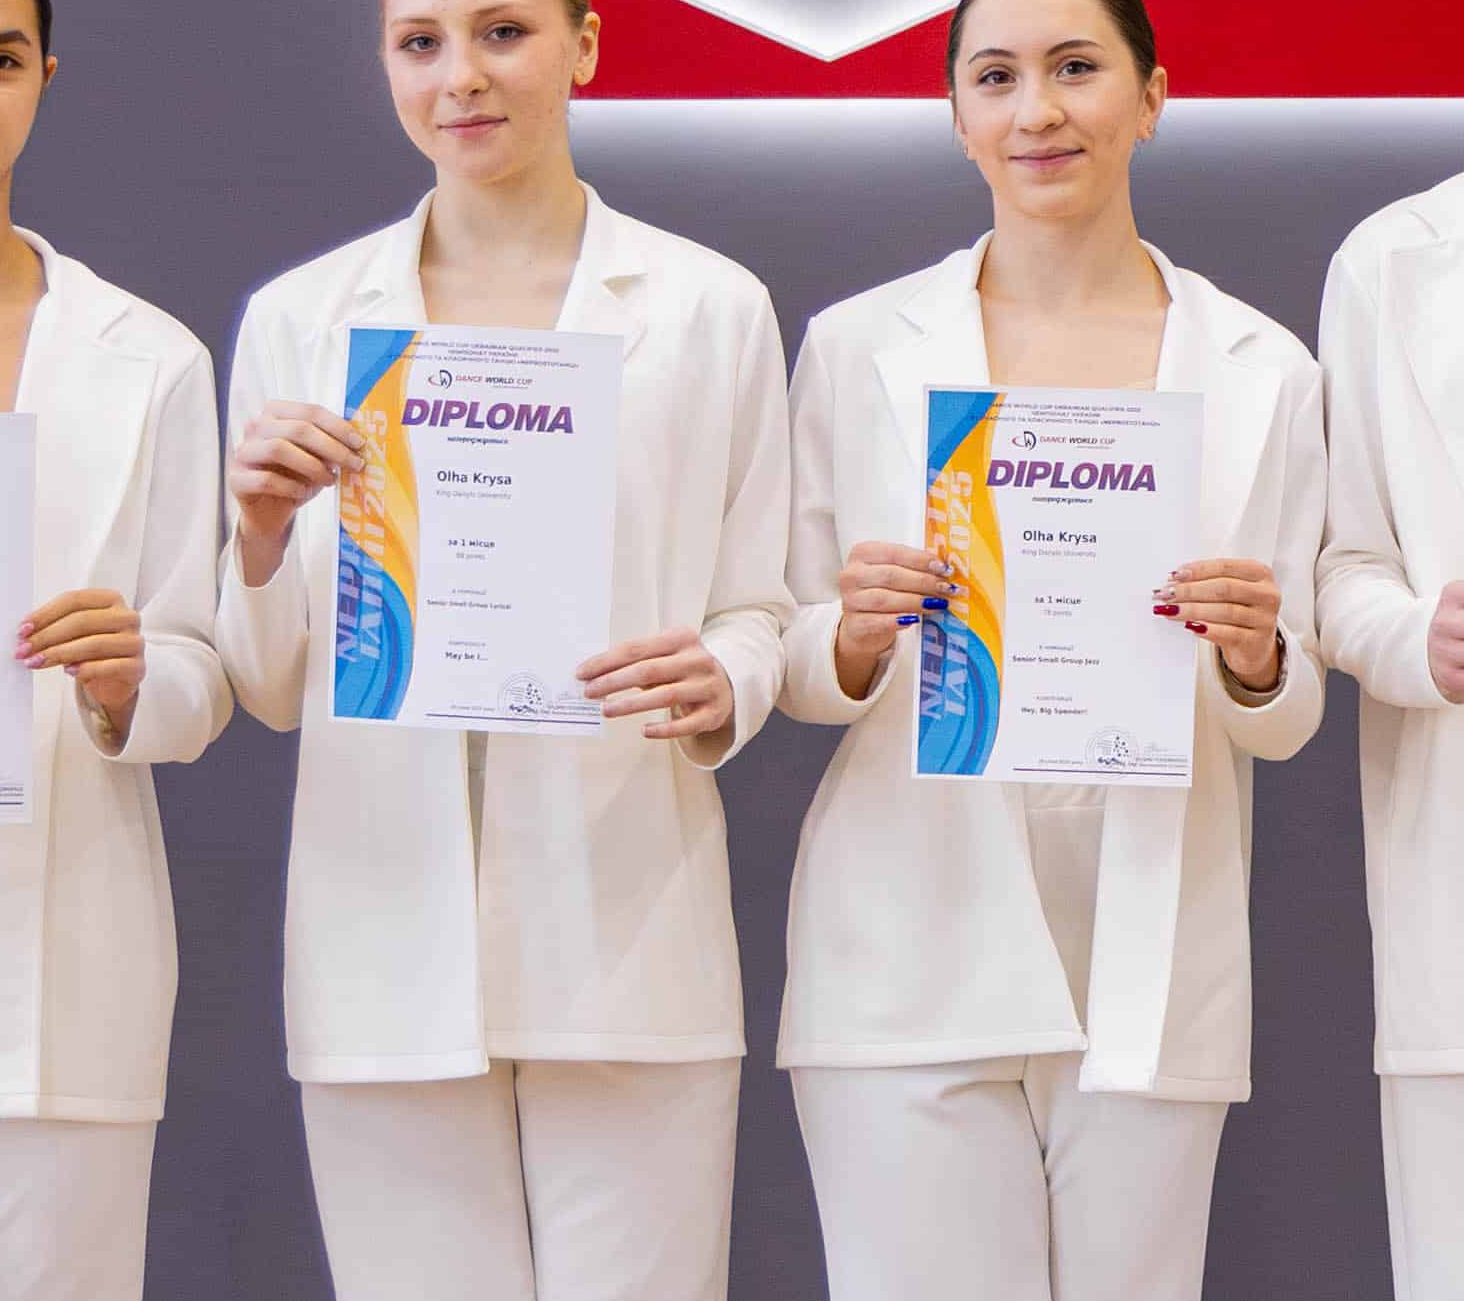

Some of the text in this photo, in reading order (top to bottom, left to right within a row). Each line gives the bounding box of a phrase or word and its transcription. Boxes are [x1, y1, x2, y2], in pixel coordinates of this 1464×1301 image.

[455, 375, 533, 386] DANCE WORLD CUP
[402, 399, 573, 433] DIPLOMA
[1040, 435, 1116, 445] DANCE WORLD CUP
[437, 470, 512, 487] Olha Krysa
[987, 460, 1155, 491] DIPLOMA
[1023, 530, 1097, 545] Olha Krysa
[446, 651, 463, 661] May
